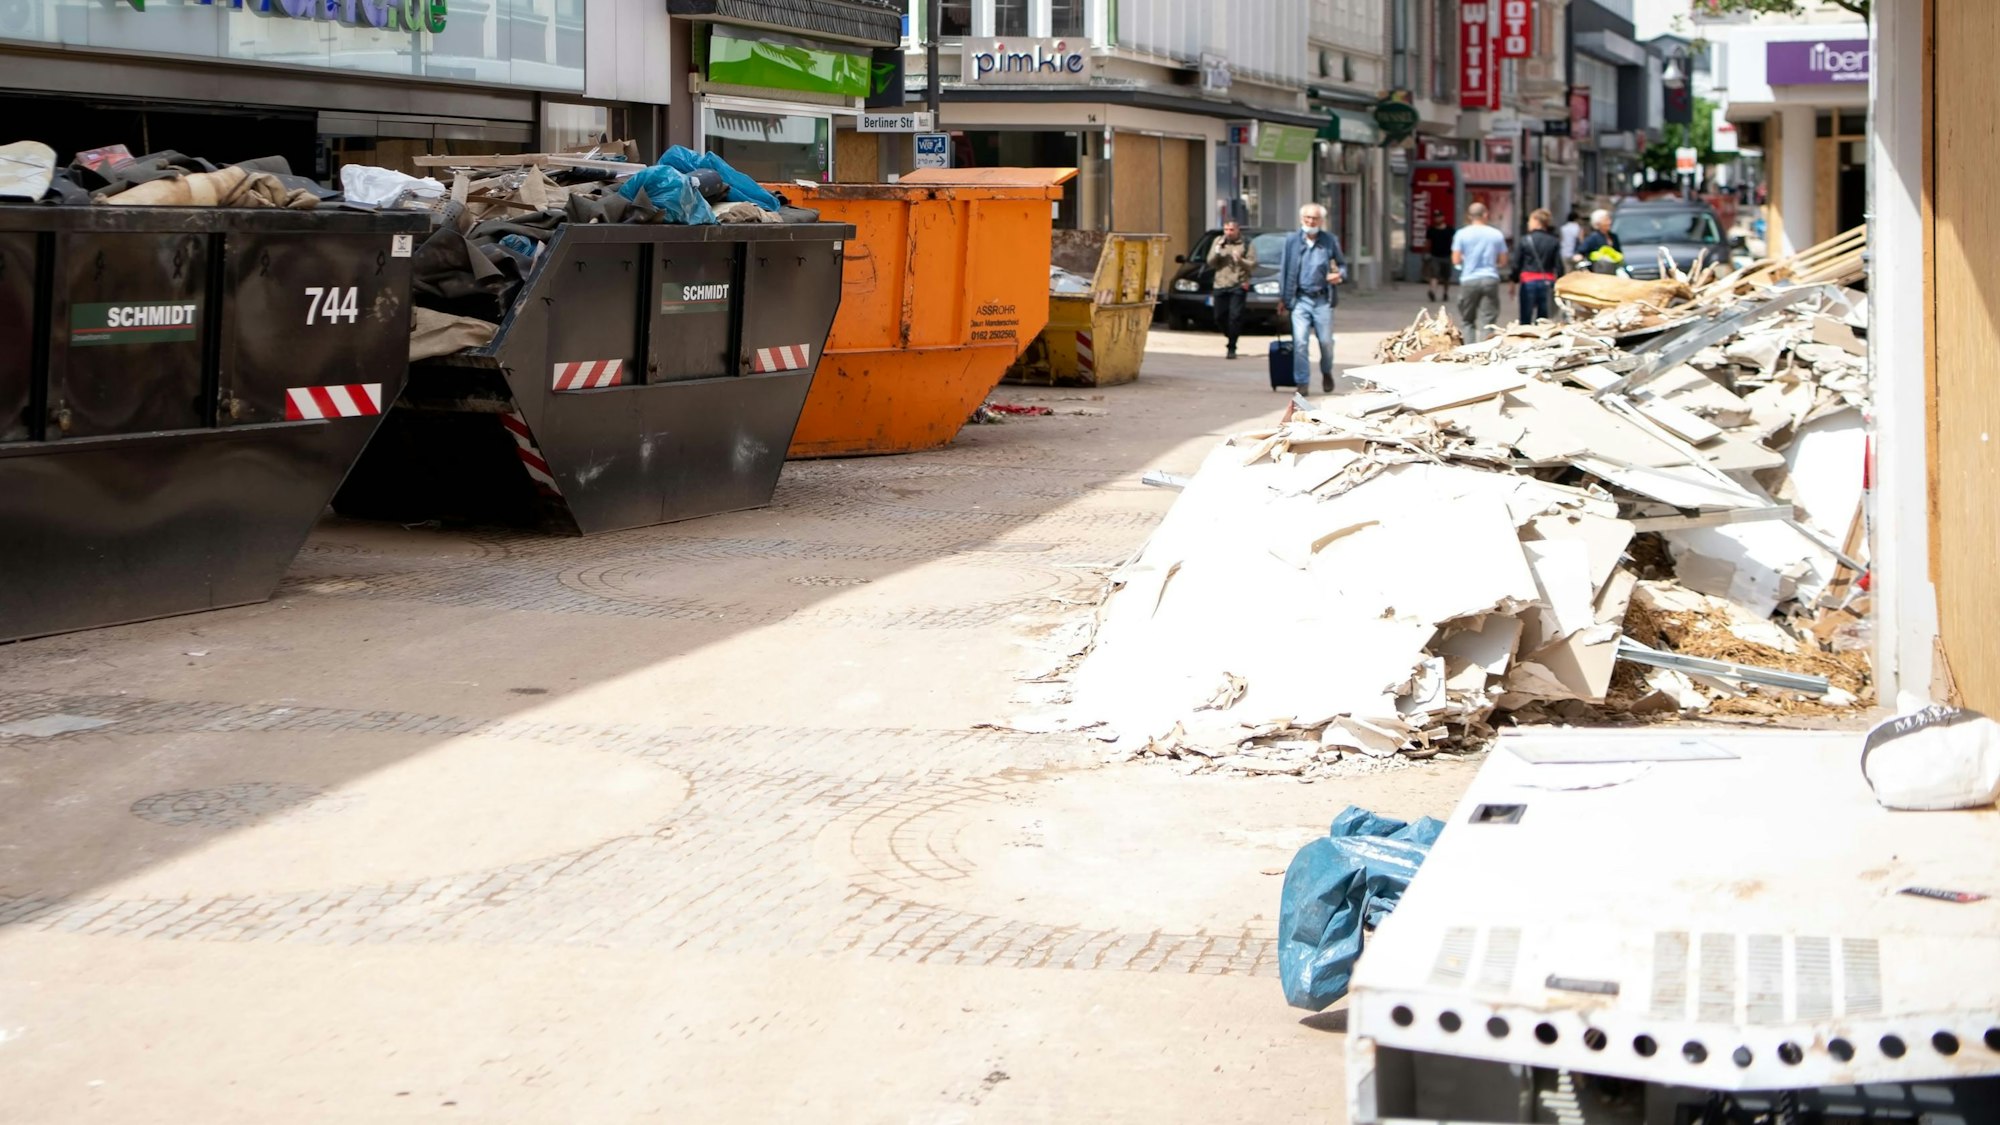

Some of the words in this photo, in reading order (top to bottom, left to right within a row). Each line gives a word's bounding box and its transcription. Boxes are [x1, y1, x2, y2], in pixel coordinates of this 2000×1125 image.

[1462, 3, 1486, 90] WITT
[972, 41, 1085, 80] pimkie
[864, 116, 898, 129] Berliner
[1088, 114, 1097, 123] 14
[683, 284, 729, 301] SCHMIDT
[305, 286, 359, 326] 744
[976, 304, 1016, 316] ASSROHR
[107, 305, 197, 328] SCHMIDT
